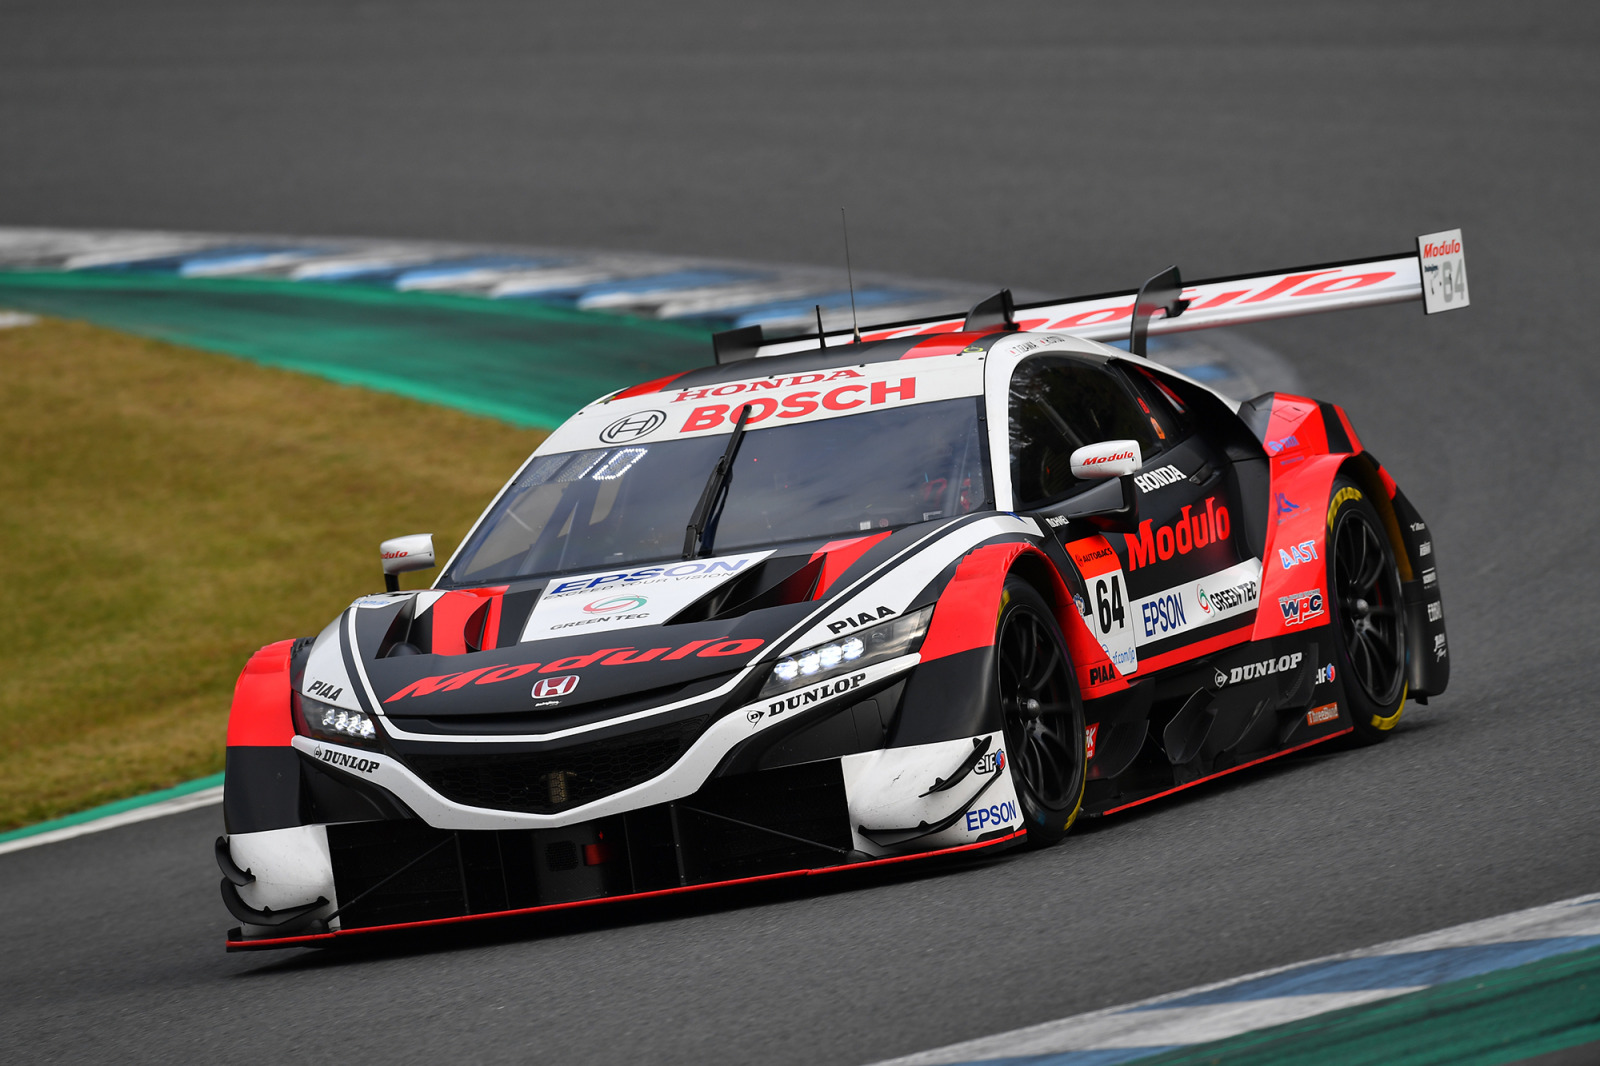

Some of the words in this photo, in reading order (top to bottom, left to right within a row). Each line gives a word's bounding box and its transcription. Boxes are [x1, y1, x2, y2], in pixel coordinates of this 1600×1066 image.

[1424, 239, 1461, 258] Modulo
[846, 269, 1397, 344] dulo
[670, 369, 865, 403] HONDA
[680, 377, 916, 432] BOSCH
[1083, 451, 1134, 466] Modulo
[1134, 464, 1187, 494] HONDA
[1123, 496, 1230, 571] Modulo
[1083, 547, 1113, 563] AUTOBACS
[543, 583, 615, 601] EXCEED
[620, 576, 668, 588] YOUR
[674, 571, 736, 582] VISION
[550, 559, 750, 596] EPSON
[1096, 575, 1124, 634] 64
[1210, 586, 1243, 612] GREEN
[1239, 580, 1257, 603] TEC
[550, 616, 610, 631] GREEN
[614, 611, 651, 621] TEC
[826, 605, 896, 635] PIAA
[1142, 592, 1187, 637] EPSON
[383, 636, 765, 704] Modulo
[1089, 664, 1116, 686] PIAA
[1229, 652, 1303, 684] DUNLOP
[307, 680, 343, 701] PIAA
[768, 672, 867, 718] DUNLOP
[323, 749, 380, 774] DUNLOP
[974, 752, 997, 775] elf
[965, 799, 1018, 832] EPSON
